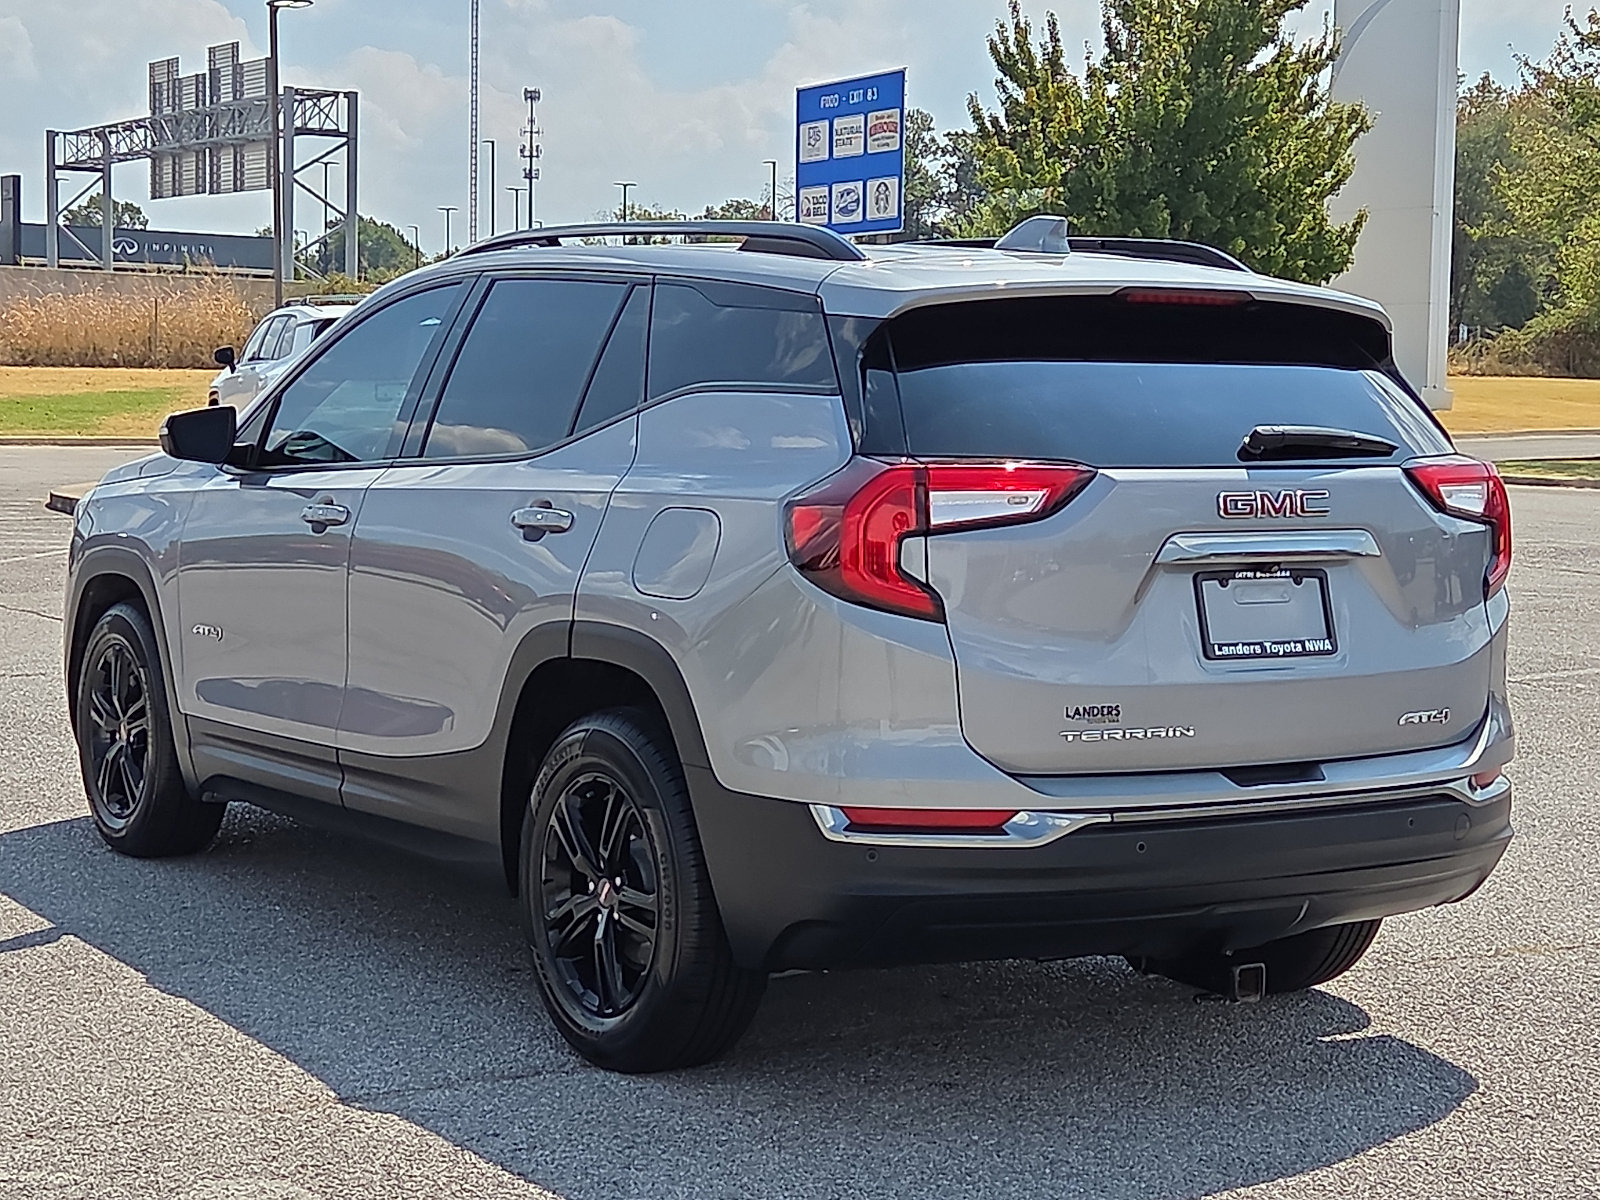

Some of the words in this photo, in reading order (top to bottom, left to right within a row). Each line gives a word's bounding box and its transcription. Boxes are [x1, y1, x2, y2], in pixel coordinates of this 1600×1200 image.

[820, 94, 839, 109] FOOD
[849, 89, 864, 105] EXIT
[866, 87, 878, 100] 83
[811, 194, 827, 205] TACO
[812, 205, 827, 217] BELL
[144, 242, 214, 254] INFINITI
[1217, 489, 1331, 518] GMC
[192, 624, 223, 641] AT4
[1214, 643, 1262, 656] Landers
[1264, 641, 1302, 655] Toyota
[1305, 639, 1332, 652] NWA
[1065, 704, 1121, 719] LANDERS
[1398, 707, 1451, 725] AT4
[1060, 726, 1195, 742] TERRAIN
